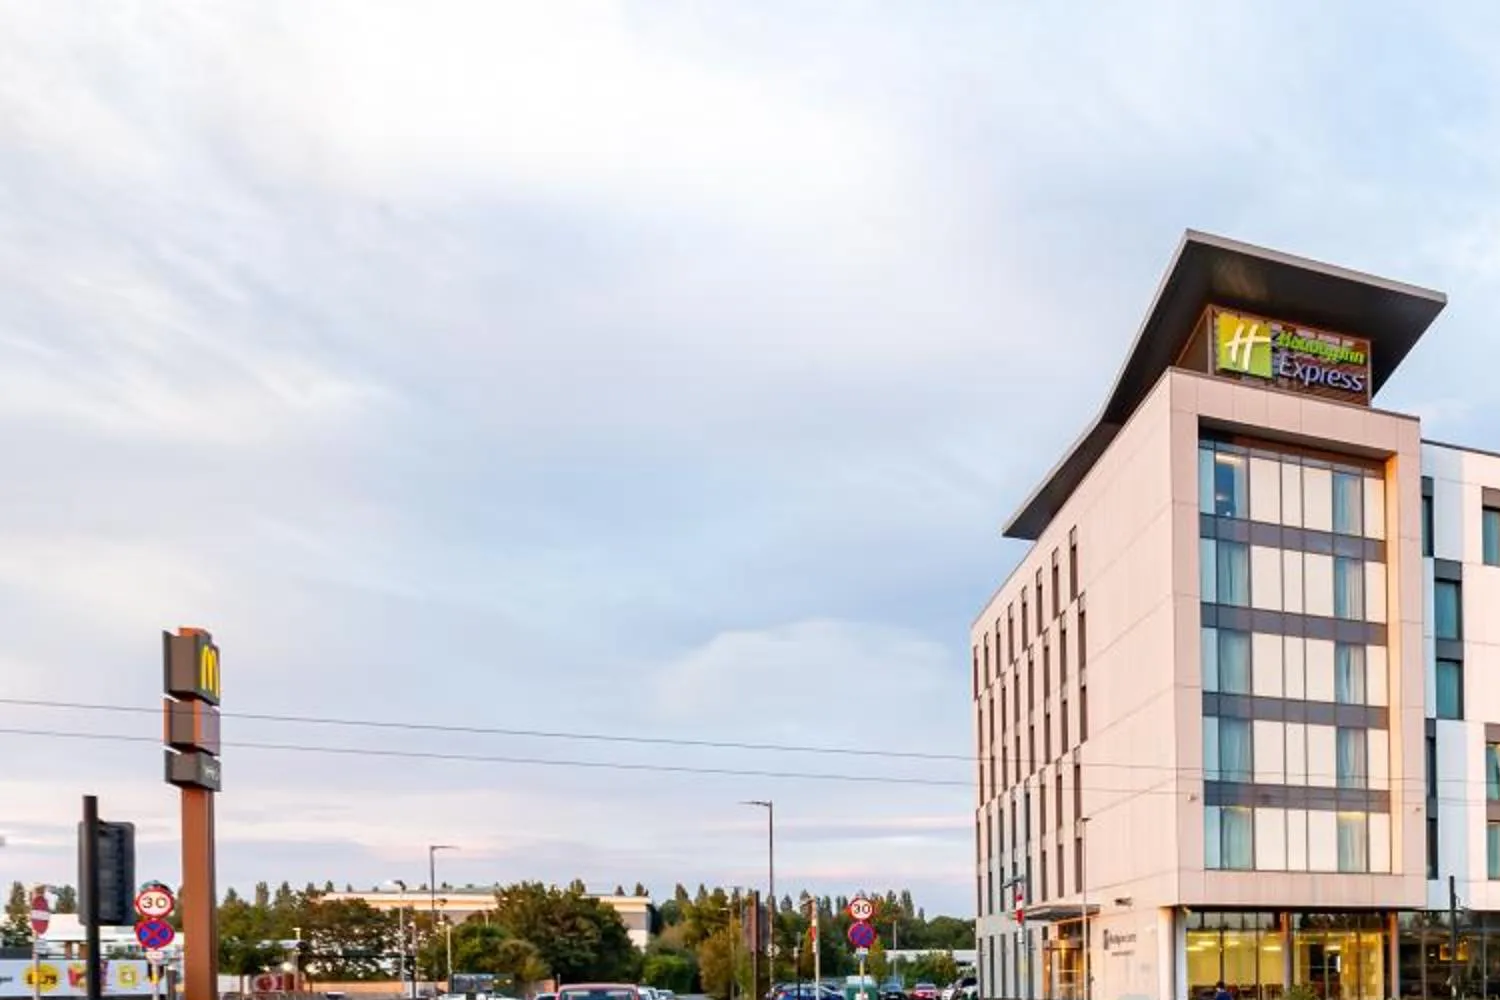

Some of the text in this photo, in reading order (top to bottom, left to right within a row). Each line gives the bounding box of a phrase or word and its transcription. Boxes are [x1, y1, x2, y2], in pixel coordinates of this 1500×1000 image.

[1279, 354, 1363, 391] Express
[142, 896, 168, 909] 30
[854, 903, 870, 914] 30
